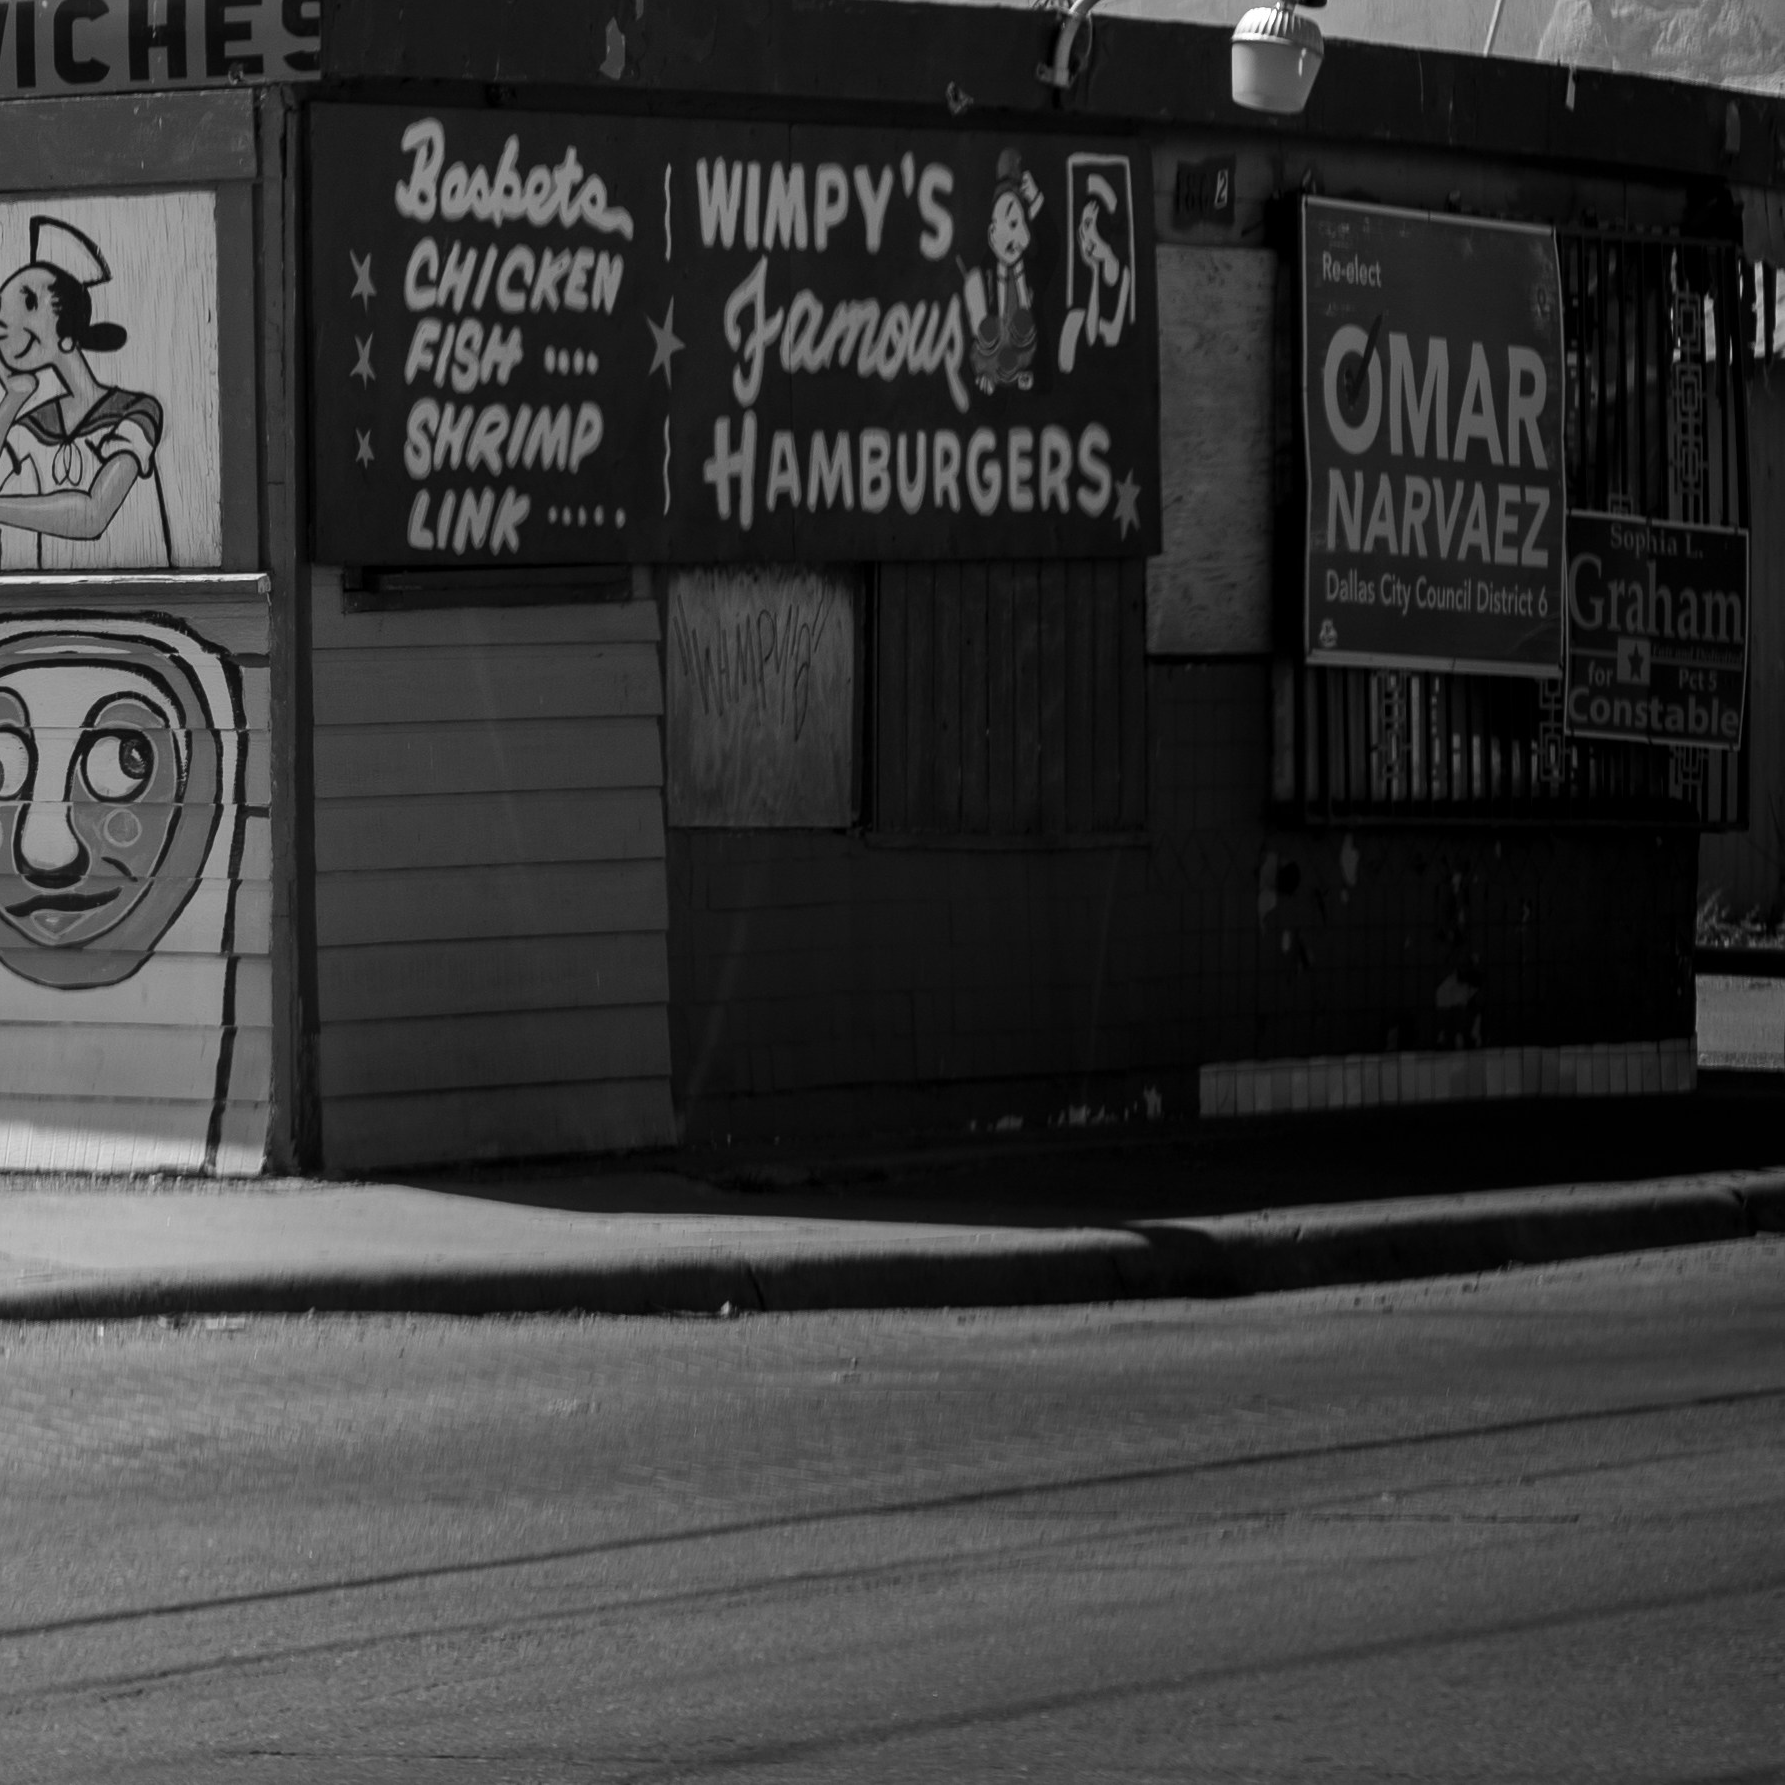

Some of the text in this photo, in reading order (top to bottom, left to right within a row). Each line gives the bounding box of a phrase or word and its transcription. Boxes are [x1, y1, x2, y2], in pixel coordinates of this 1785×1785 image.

[695, 150, 956, 260] WIMPY'S
[403, 236, 625, 316] CHICKEN
[1321, 249, 1383, 289] Re-elect
[404, 318, 524, 394] FISH
[723, 254, 971, 414] Famous
[1322, 323, 1549, 471] OMAR
[403, 396, 605, 480] SHRIMP
[703, 408, 1114, 532] HAMBURGERS
[406, 486, 532, 555] LINK
[1326, 466, 1551, 570] NARVAEZ
[1609, 521, 1678, 561] Sophia
[1325, 568, 1549, 618] Dallas City Council District 6
[1567, 551, 1745, 645] Graham
[1567, 684, 1739, 737] Constable
[1587, 658, 1614, 688] for
[1678, 666, 1705, 692] Pct
